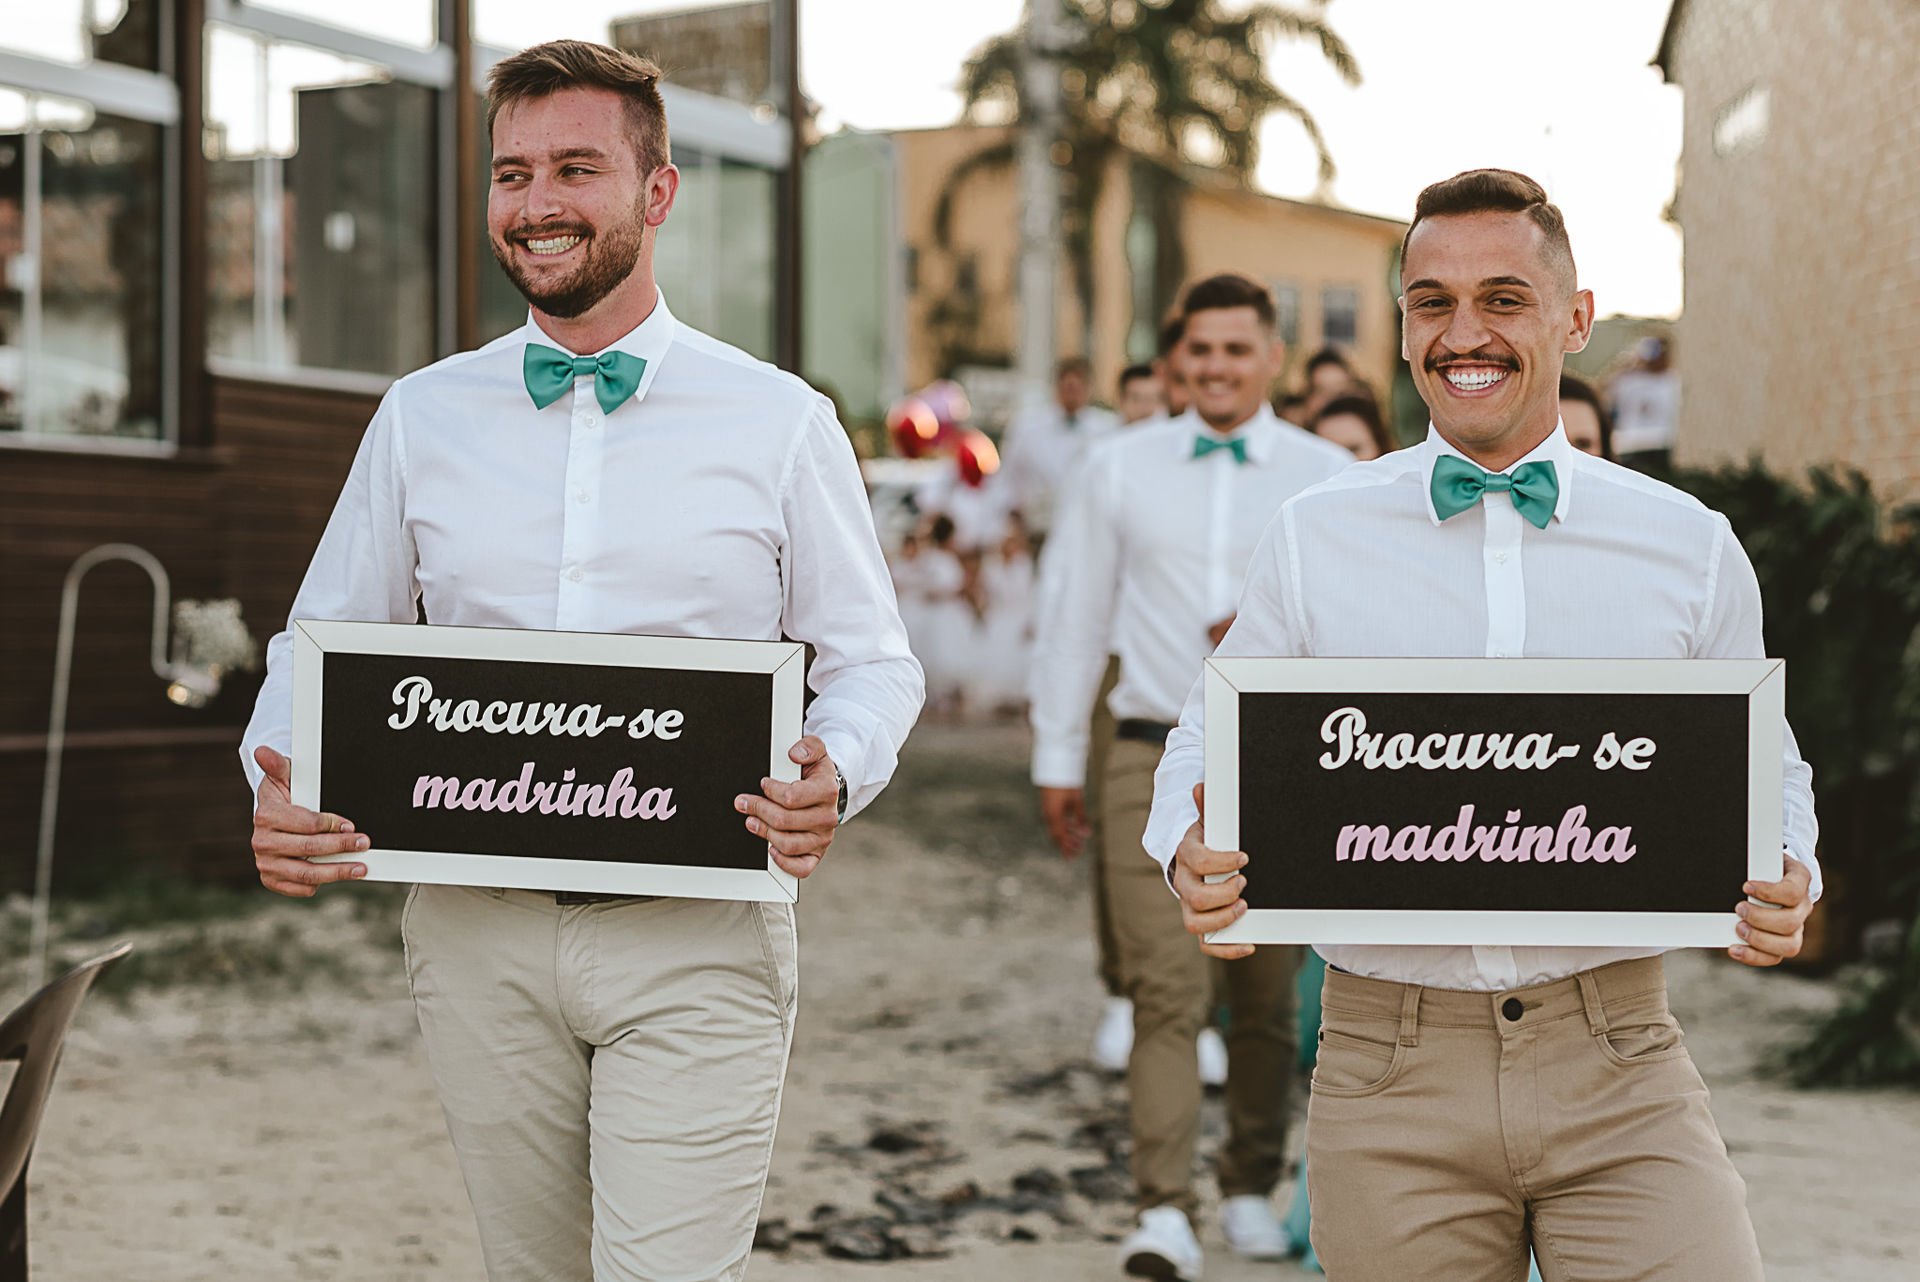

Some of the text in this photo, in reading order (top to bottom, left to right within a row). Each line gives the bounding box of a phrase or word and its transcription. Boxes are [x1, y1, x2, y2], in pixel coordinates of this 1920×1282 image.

[387, 675, 685, 741] Procura-se
[412, 761, 677, 821] madrinha
[1335, 803, 1637, 864] madrinha
